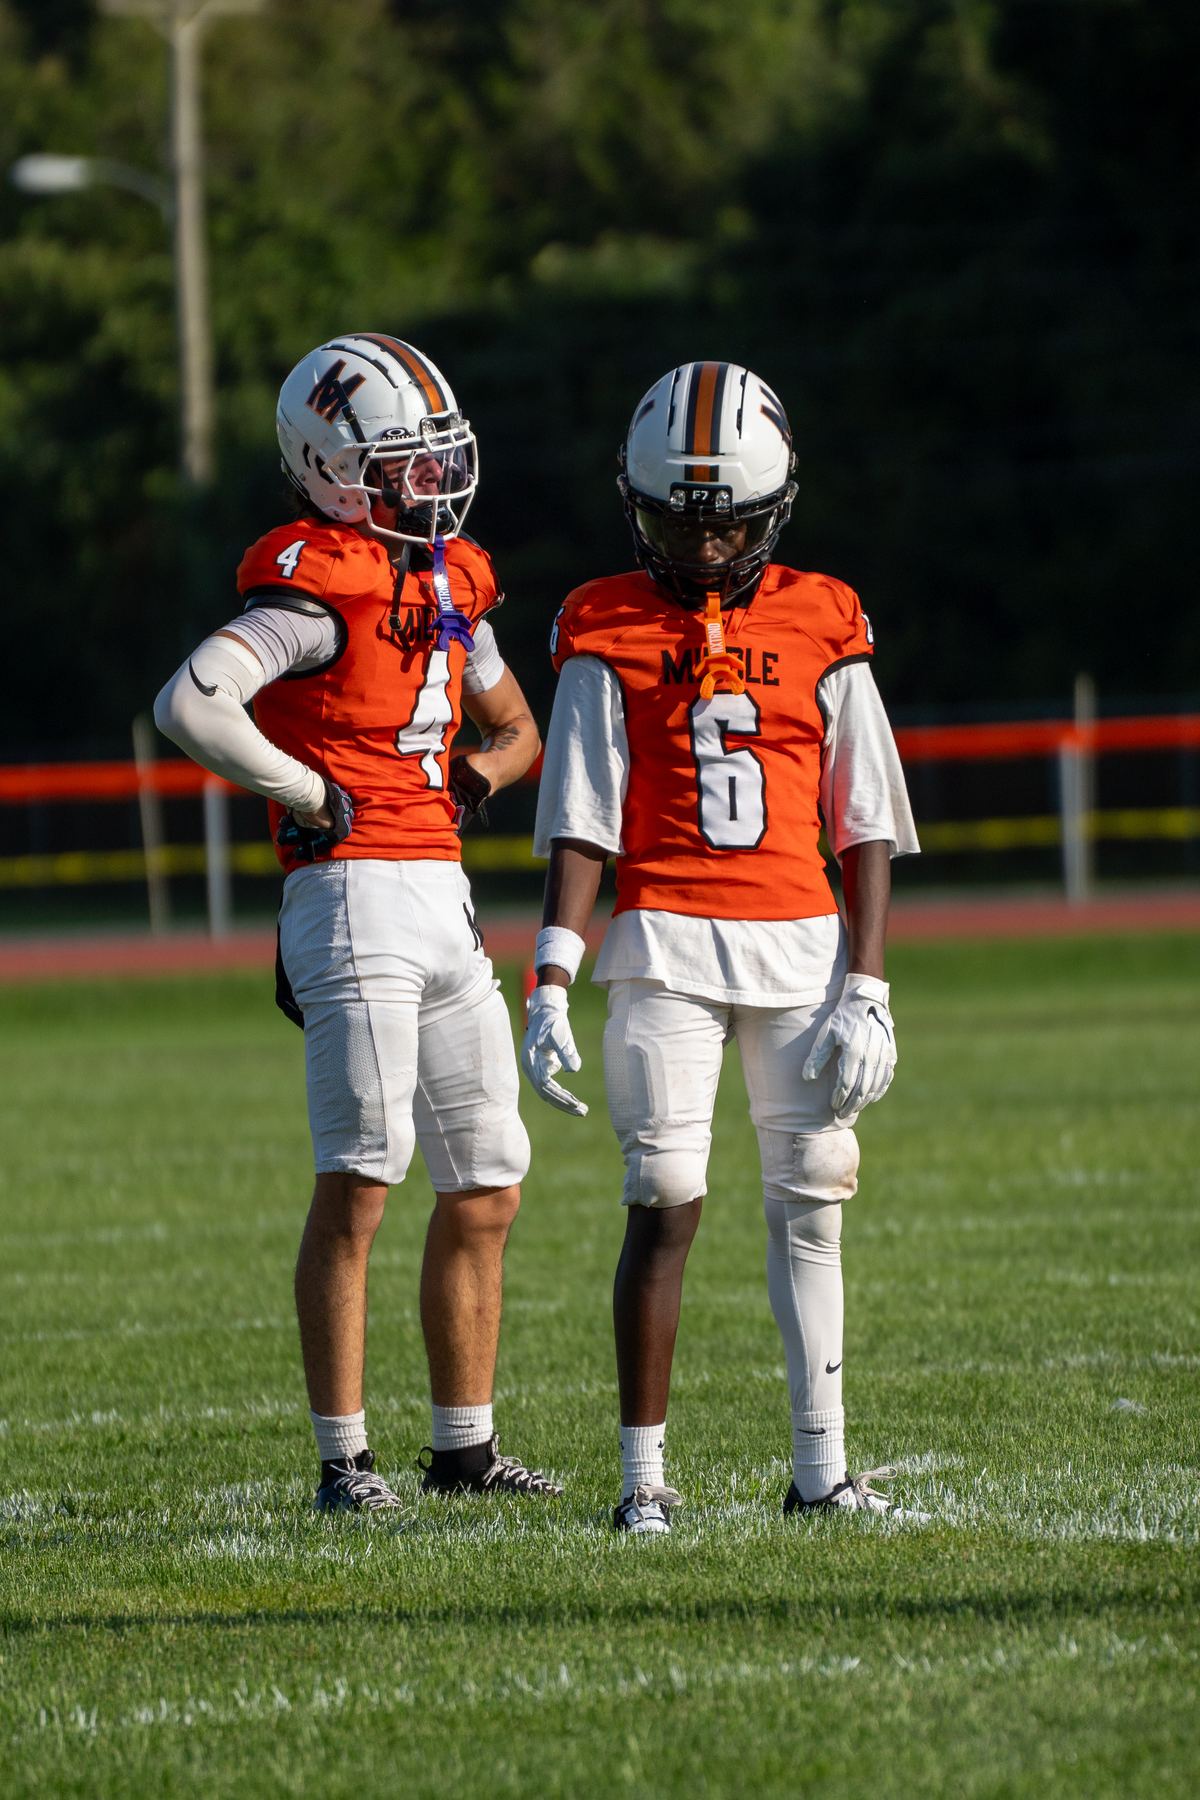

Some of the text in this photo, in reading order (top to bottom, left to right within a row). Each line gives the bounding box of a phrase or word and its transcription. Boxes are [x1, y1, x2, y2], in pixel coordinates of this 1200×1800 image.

[276, 540, 307, 579] 4
[708, 623, 724, 654] NXTRND
[395, 649, 453, 791] 4
[689, 689, 768, 850] 6
